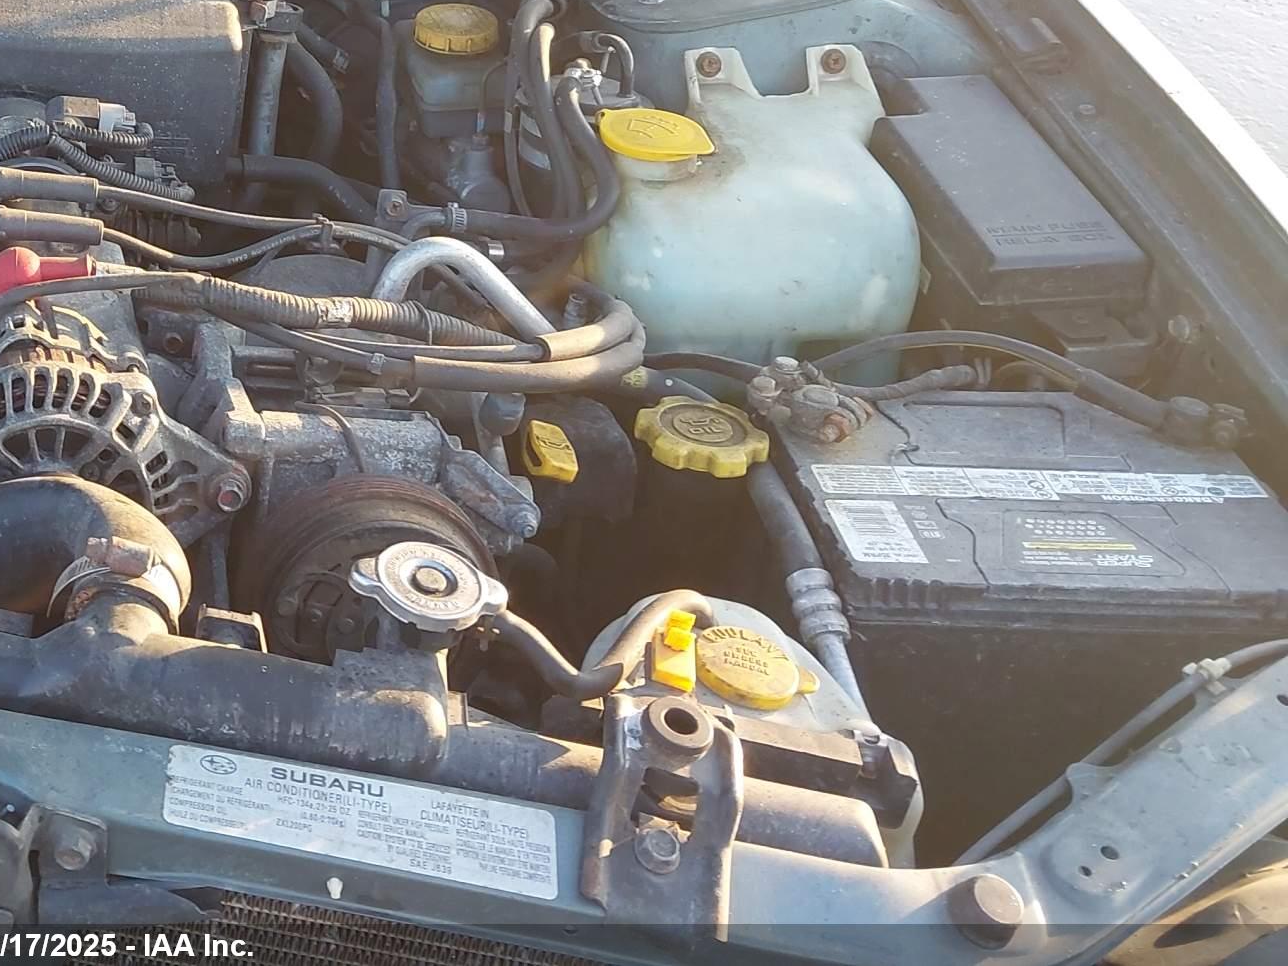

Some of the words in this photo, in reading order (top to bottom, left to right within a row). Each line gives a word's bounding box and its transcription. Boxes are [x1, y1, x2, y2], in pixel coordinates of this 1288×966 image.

[688, 425, 722, 436] OIL
[702, 627, 790, 662] COOLANT
[244, 777, 262, 789] AIR
[271, 767, 383, 797] SUBARU
[432, 800, 478, 816] LAFAYETTE
[409, 858, 426, 869] SAE
